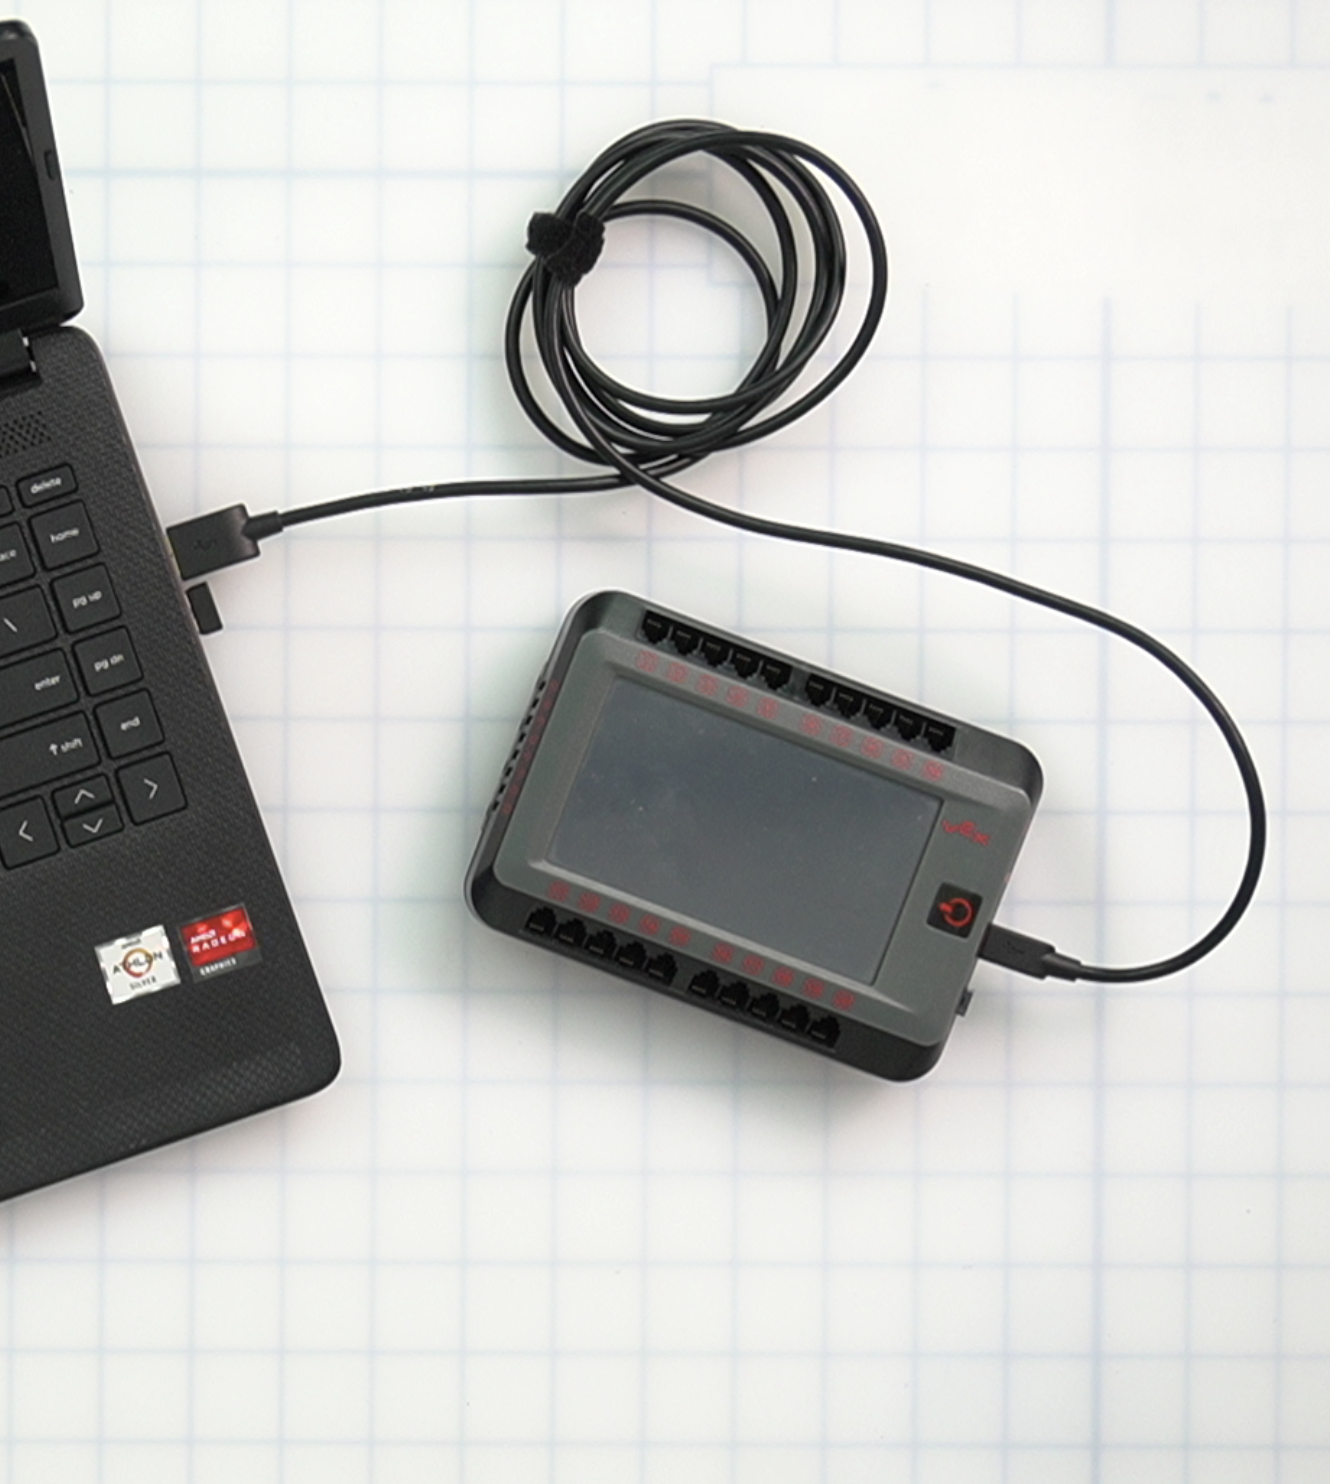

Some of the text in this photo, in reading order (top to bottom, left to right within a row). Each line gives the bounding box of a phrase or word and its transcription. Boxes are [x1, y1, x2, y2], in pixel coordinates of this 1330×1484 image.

[49, 528, 80, 543] home
[72, 590, 102, 609] pg up
[94, 659, 109, 672] pg
[34, 675, 60, 691] enter
